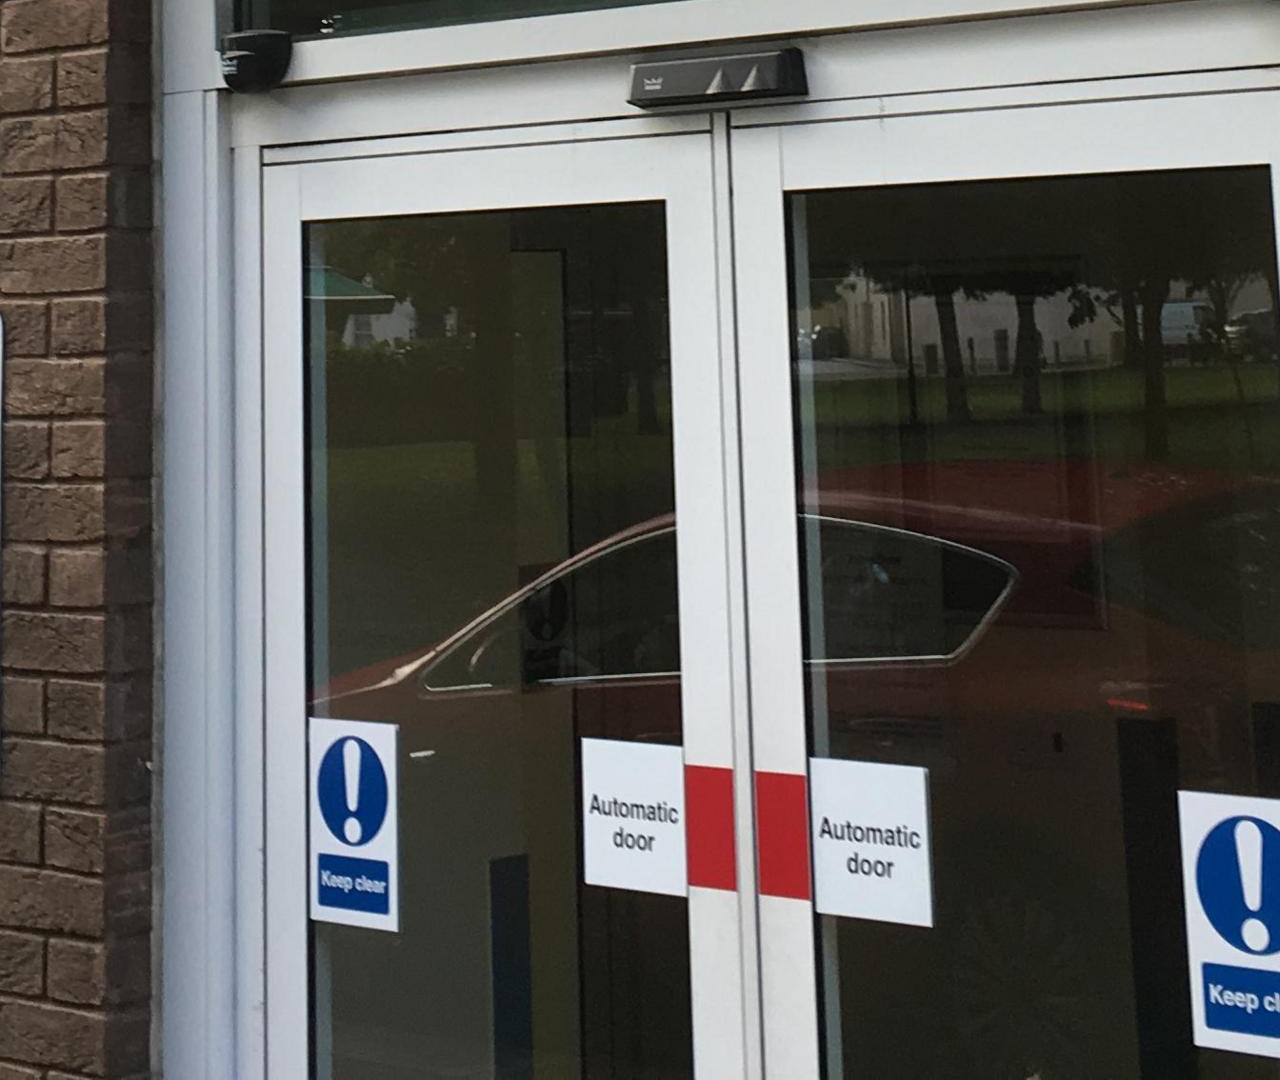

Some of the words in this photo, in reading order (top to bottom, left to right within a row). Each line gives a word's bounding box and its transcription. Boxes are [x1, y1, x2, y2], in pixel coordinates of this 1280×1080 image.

[589, 794, 680, 825] Automatic
[613, 827, 656, 852] door
[819, 816, 922, 850] Automatic
[846, 852, 895, 879] door
[321, 869, 353, 894] Keep
[354, 874, 387, 894] clear
[1208, 983, 1259, 1015] Keep
